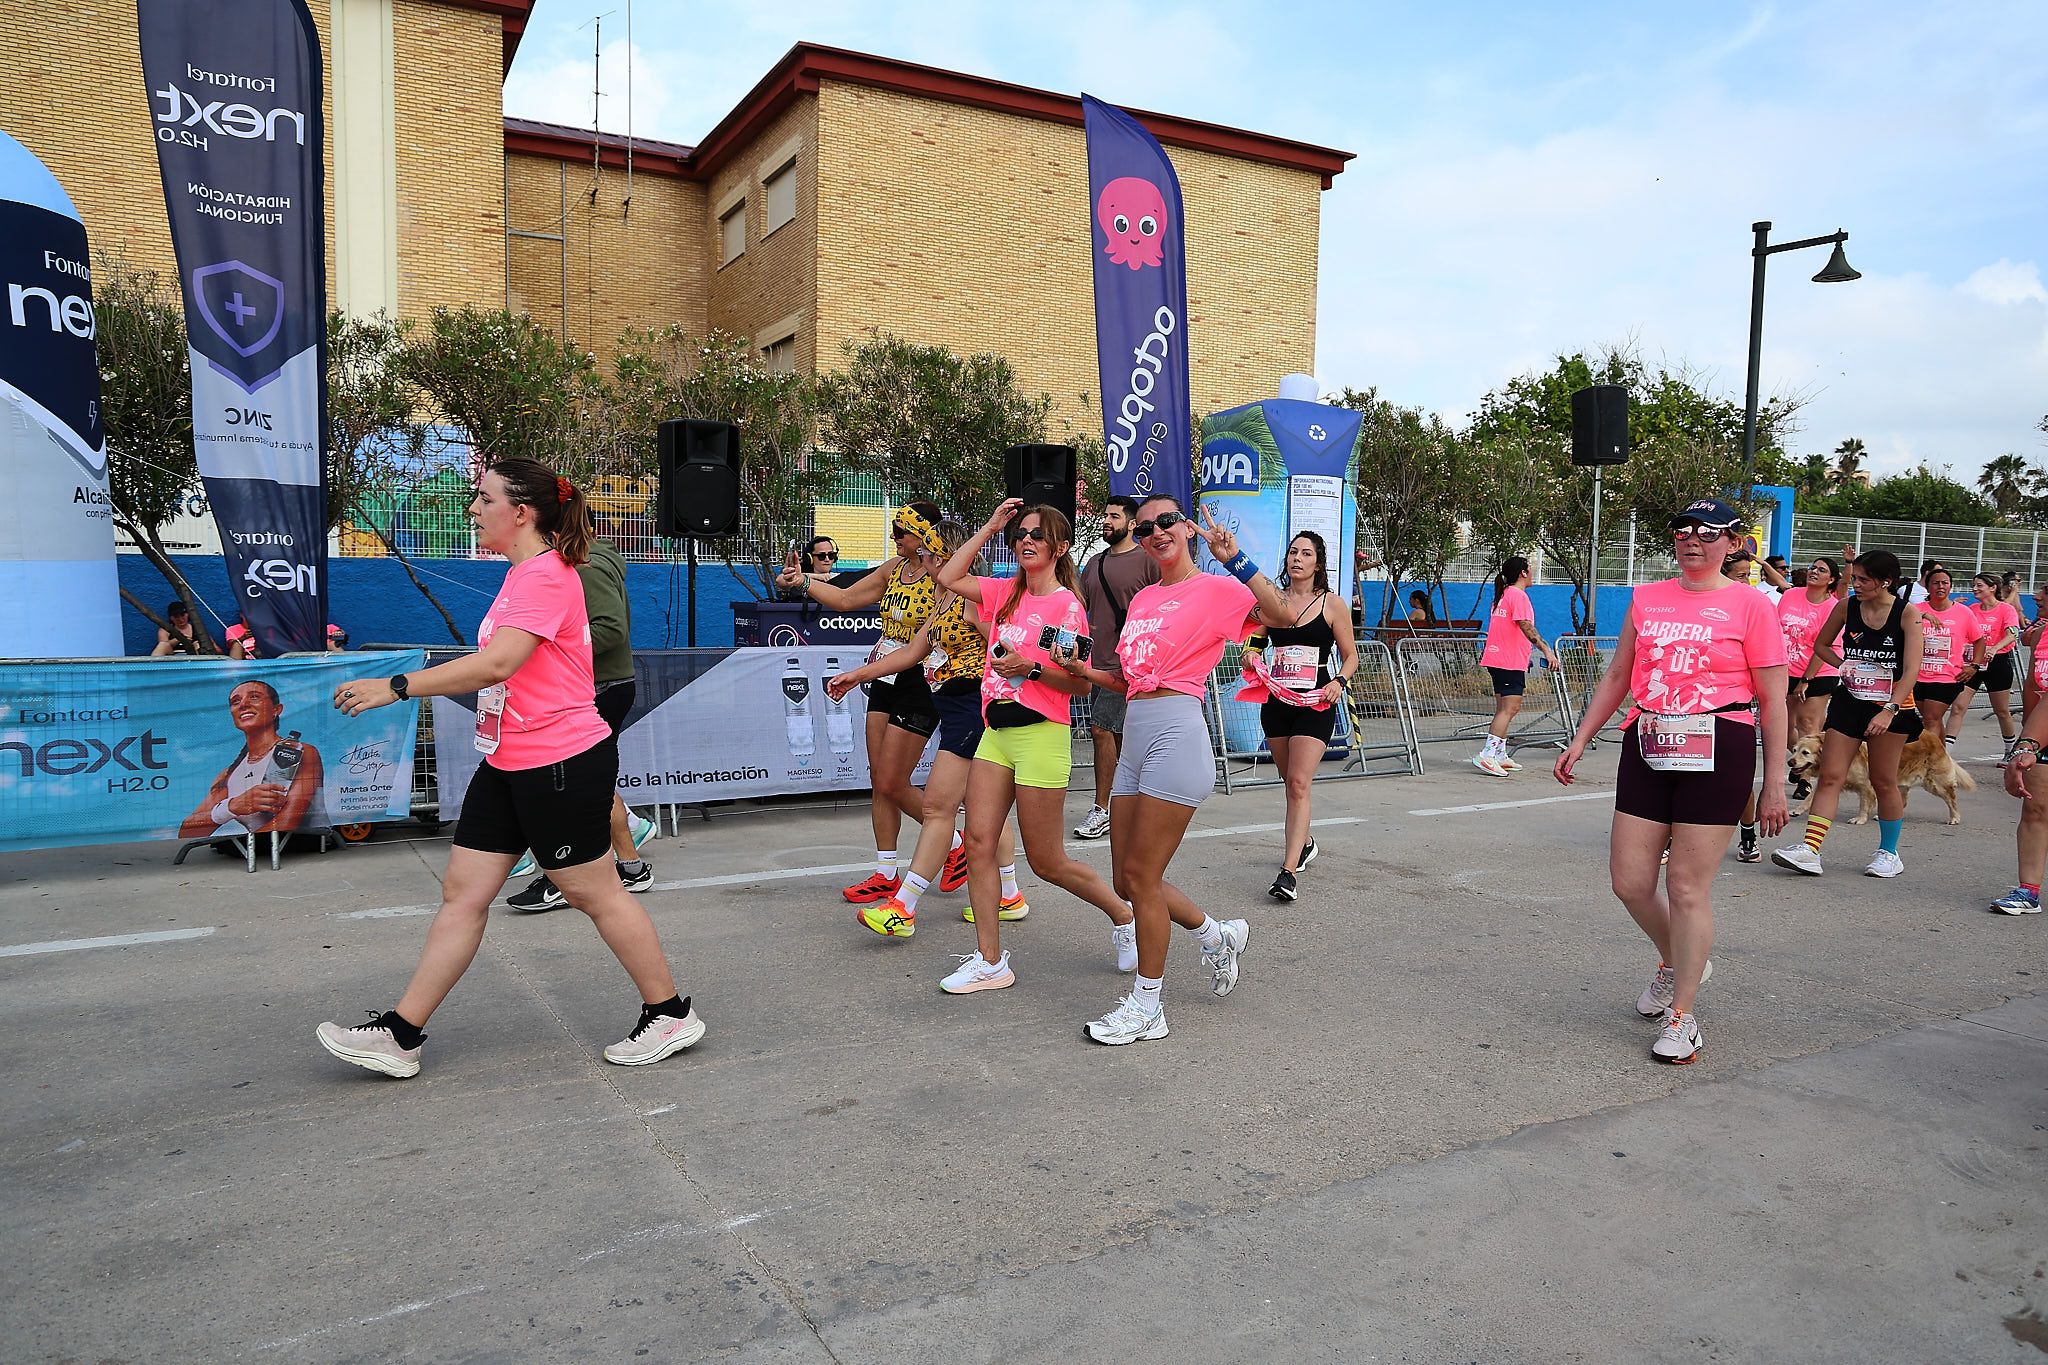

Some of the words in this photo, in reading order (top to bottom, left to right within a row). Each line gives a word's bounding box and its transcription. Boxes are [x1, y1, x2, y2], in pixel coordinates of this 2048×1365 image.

[1201, 453, 1253, 487] OYA
[819, 615, 883, 633] octopus
[1845, 647, 1897, 659] VALENCIA
[1283, 664, 1302, 672] 016
[1854, 677, 1875, 685] 016
[786, 684, 805, 692] next
[19, 705, 129, 724] Fontarel
[1657, 733, 1687, 746] 016
[616, 774, 642, 789] de
[646, 772, 662, 786] la
[665, 765, 769, 786] hidratación
[787, 768, 823, 777] MAGNESIO
[107, 775, 169, 794] H2.0
[339, 786, 369, 795] Marta
